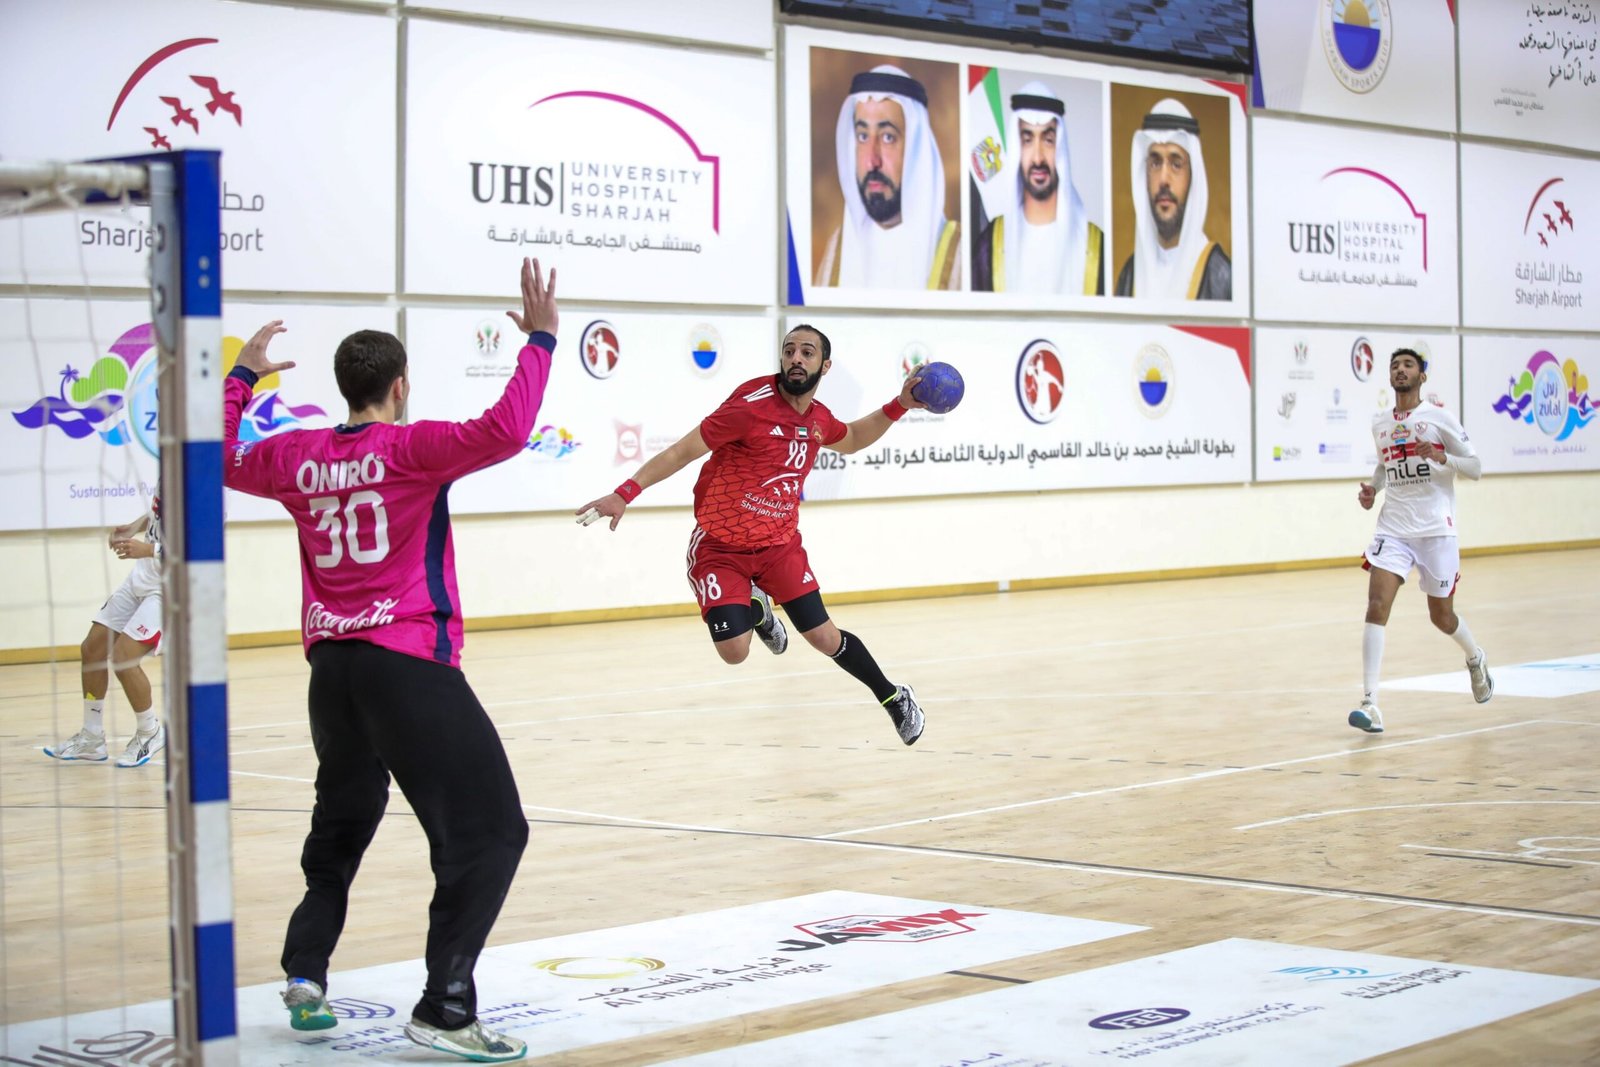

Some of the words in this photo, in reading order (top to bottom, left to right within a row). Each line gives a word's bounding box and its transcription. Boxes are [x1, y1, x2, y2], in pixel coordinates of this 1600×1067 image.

[571, 162, 702, 184] UNIVERSITY
[468, 162, 555, 207] UHS
[571, 182, 678, 203] HOSPITAL
[571, 203, 671, 222] SHARJAH
[487, 225, 563, 250] بالشارقة
[1288, 221, 1336, 255] UHS
[1344, 221, 1417, 236] UNIVERSITY
[566, 230, 627, 252] الجامعة
[629, 233, 702, 254] مستشفى
[1344, 235, 1404, 250] HOSPITAL
[1344, 251, 1401, 264] SHARJAH
[1514, 260, 1556, 285] الشارقة
[1557, 263, 1583, 287] مطار
[1515, 287, 1550, 309] Sharjah
[1551, 289, 1583, 310] Airport
[785, 439, 808, 469] 98
[863, 447, 891, 470] اليد
[894, 447, 926, 469] لكرة
[929, 443, 974, 464] الثامنة
[978, 443, 1024, 466] الدولية
[1027, 441, 1082, 469] القاسمي
[1086, 440, 1111, 458] خالد
[1114, 442, 1129, 461] بن
[1133, 444, 1163, 458] محمد
[1165, 437, 1201, 460] الشيخ
[1202, 438, 1235, 458] بطولة
[812, 452, 847, 470] 2025
[296, 452, 385, 494] ONIRO
[69, 484, 136, 499] Sustainable
[741, 500, 771, 517] Sharjah
[309, 490, 390, 568] 30
[776, 908, 990, 952] JAMIX
[604, 997, 642, 1009] Al
[641, 981, 734, 1001] Shaab
[727, 962, 832, 983] Village
